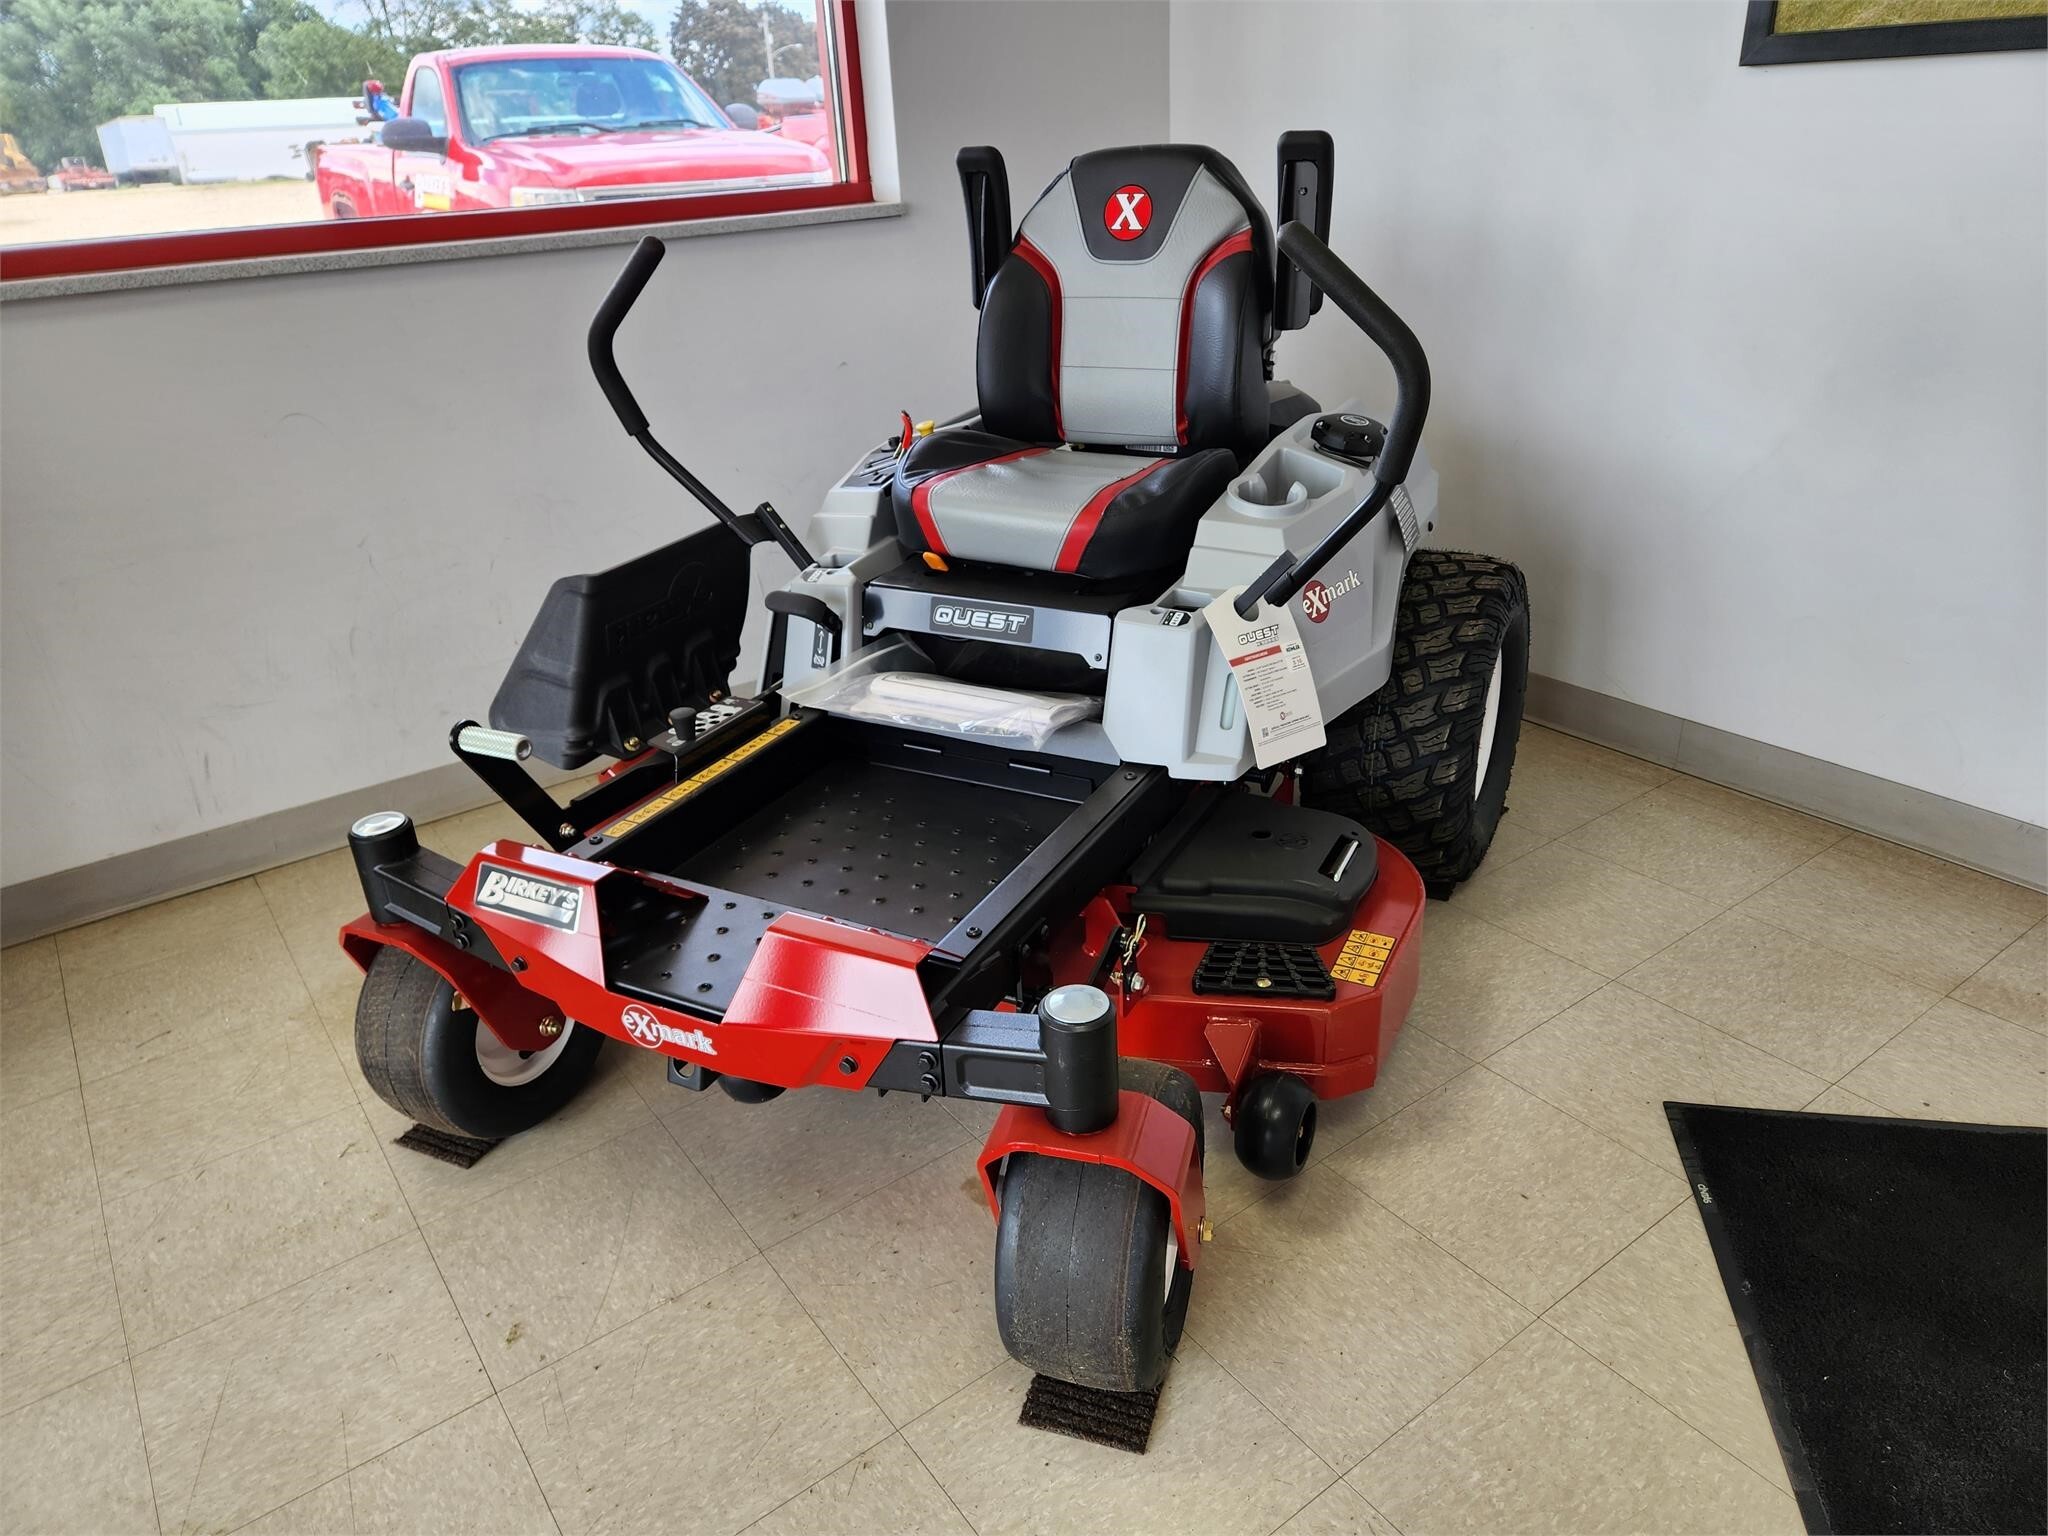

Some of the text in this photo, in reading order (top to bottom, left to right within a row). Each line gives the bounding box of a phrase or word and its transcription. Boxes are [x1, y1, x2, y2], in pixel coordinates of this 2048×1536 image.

[1110, 193, 1145, 230] X
[1303, 570, 1361, 618] eXmark
[934, 605, 1029, 634] QUEST
[1238, 624, 1279, 645] QUEST
[477, 871, 580, 911] BIRKEY'S
[622, 1009, 718, 1056] eXmark
